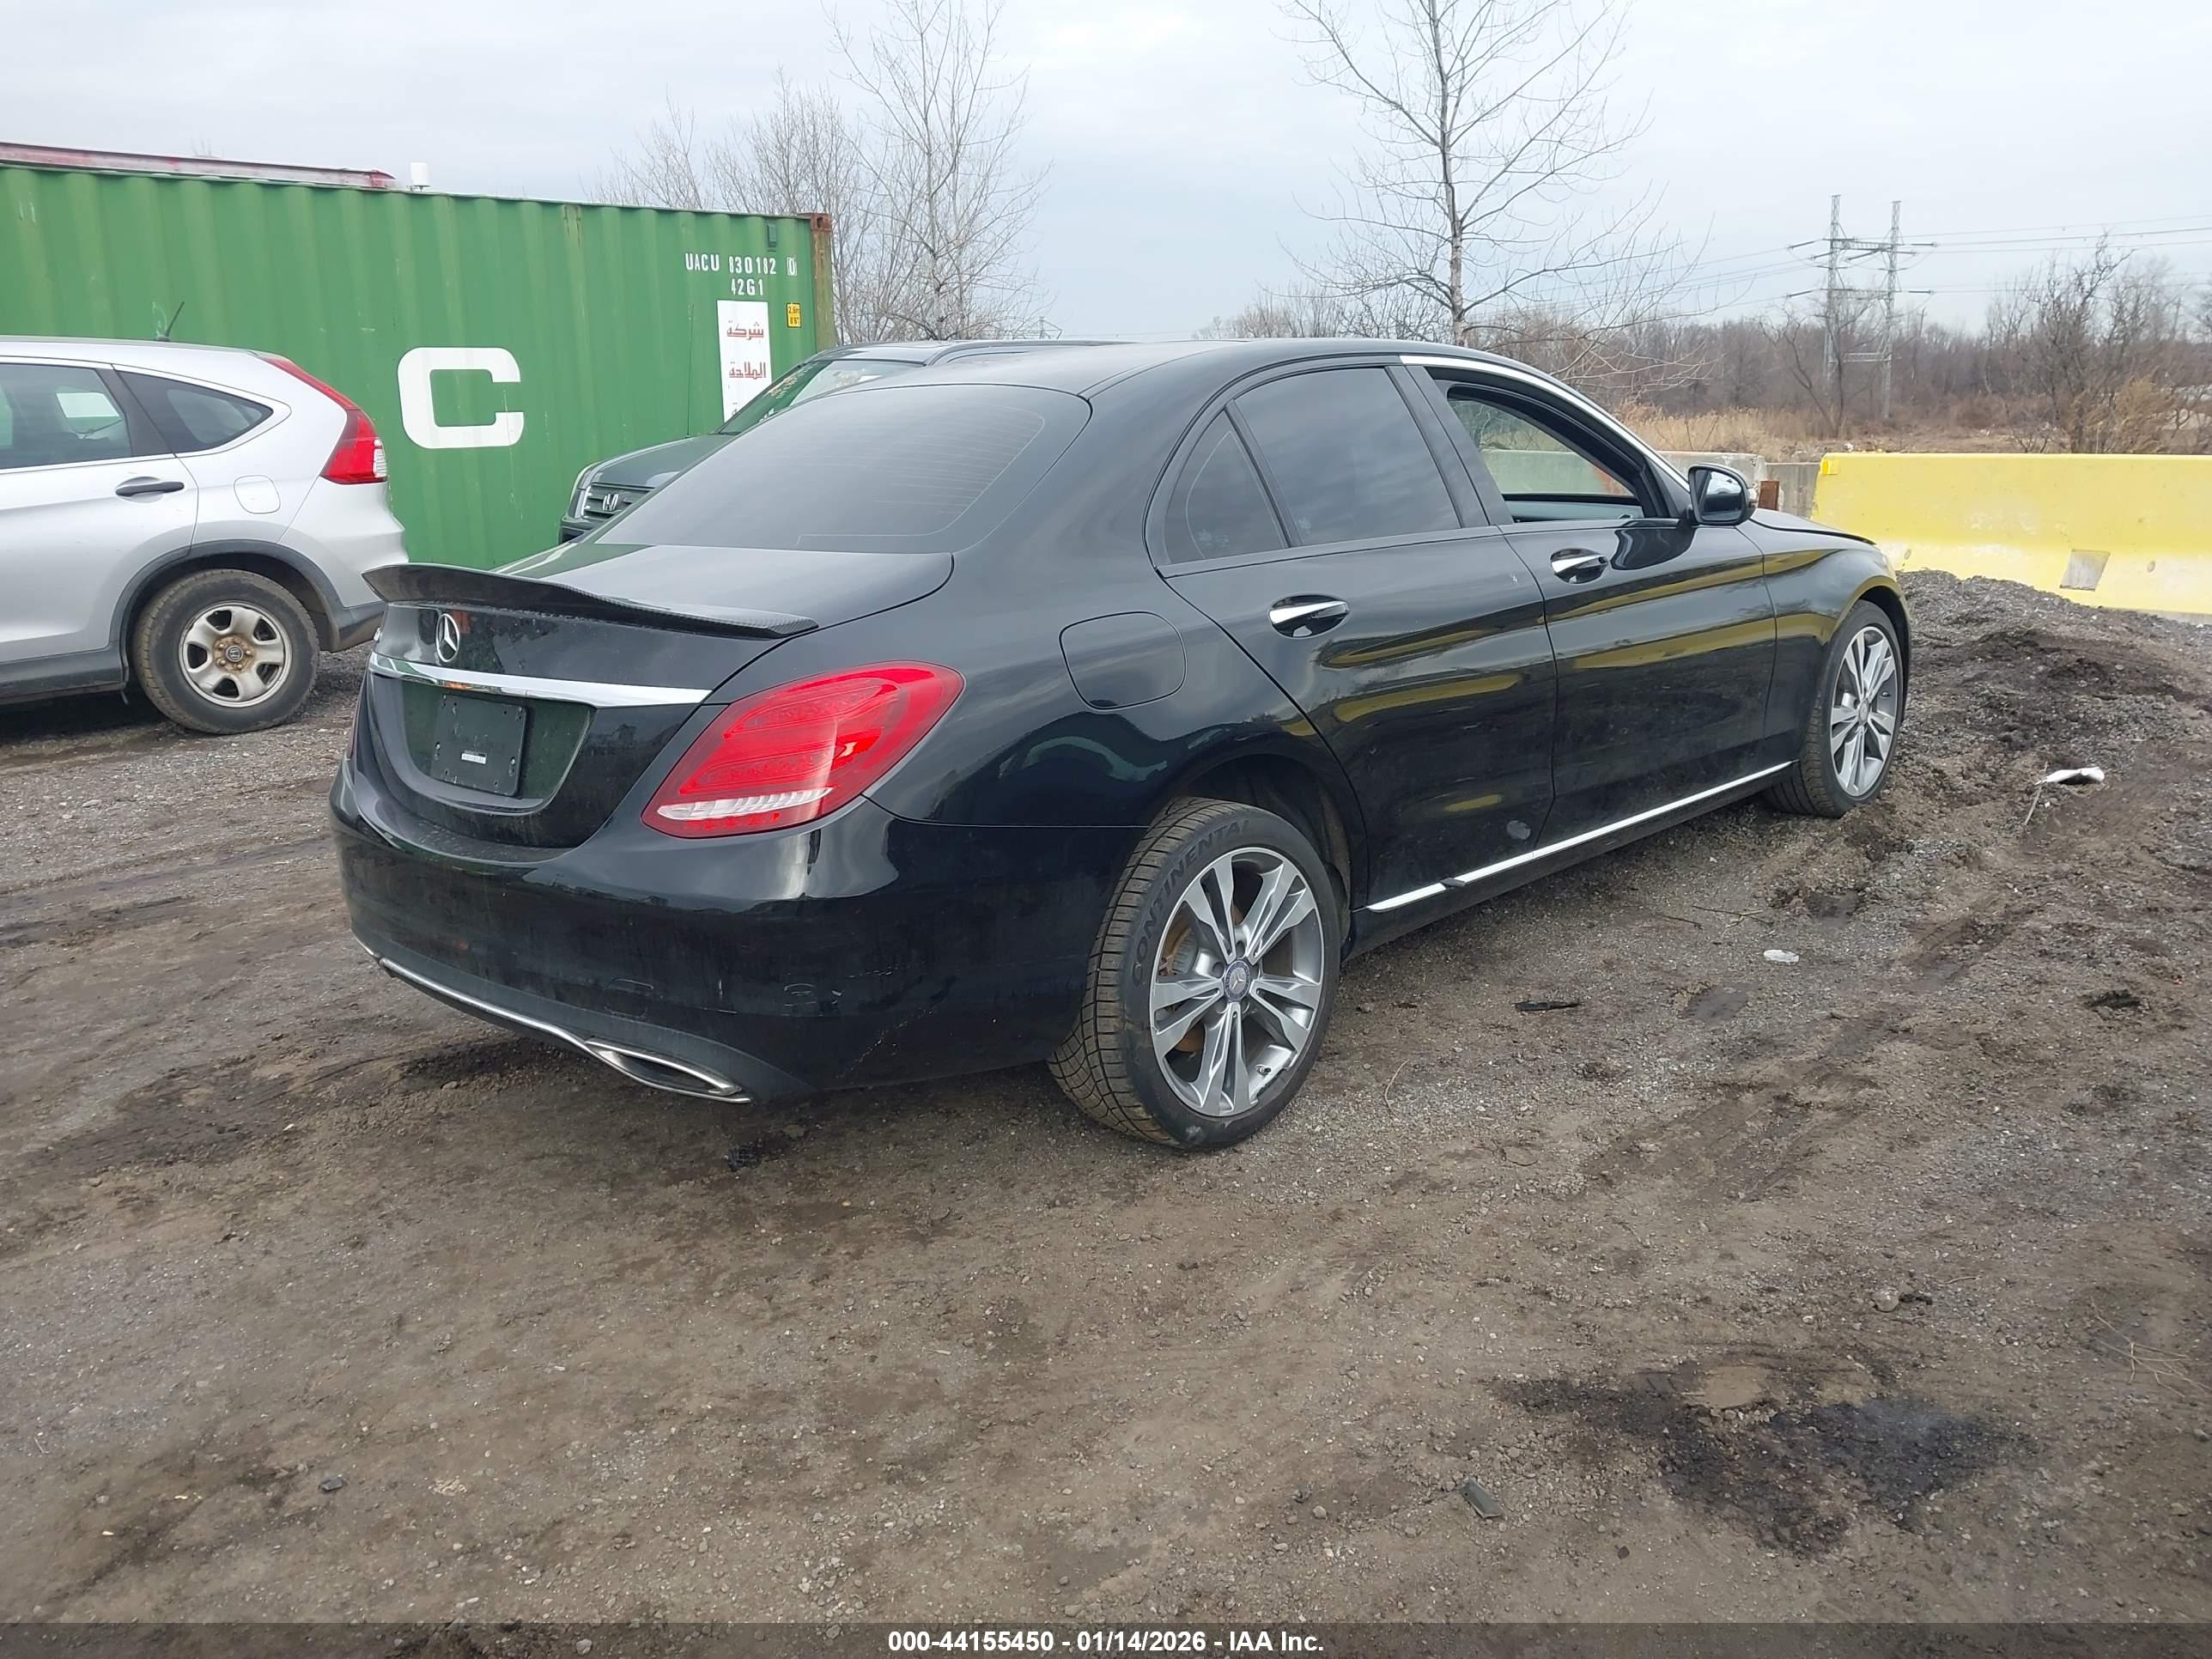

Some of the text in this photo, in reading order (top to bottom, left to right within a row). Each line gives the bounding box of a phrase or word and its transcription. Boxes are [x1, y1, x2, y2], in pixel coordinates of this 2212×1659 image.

[684, 252, 720, 271] UACU
[728, 256, 777, 275] 830182
[731, 277, 763, 296] 42G1
[726, 319, 765, 341] شركة
[728, 361, 767, 380] الملاحة
[397, 347, 525, 449] C
